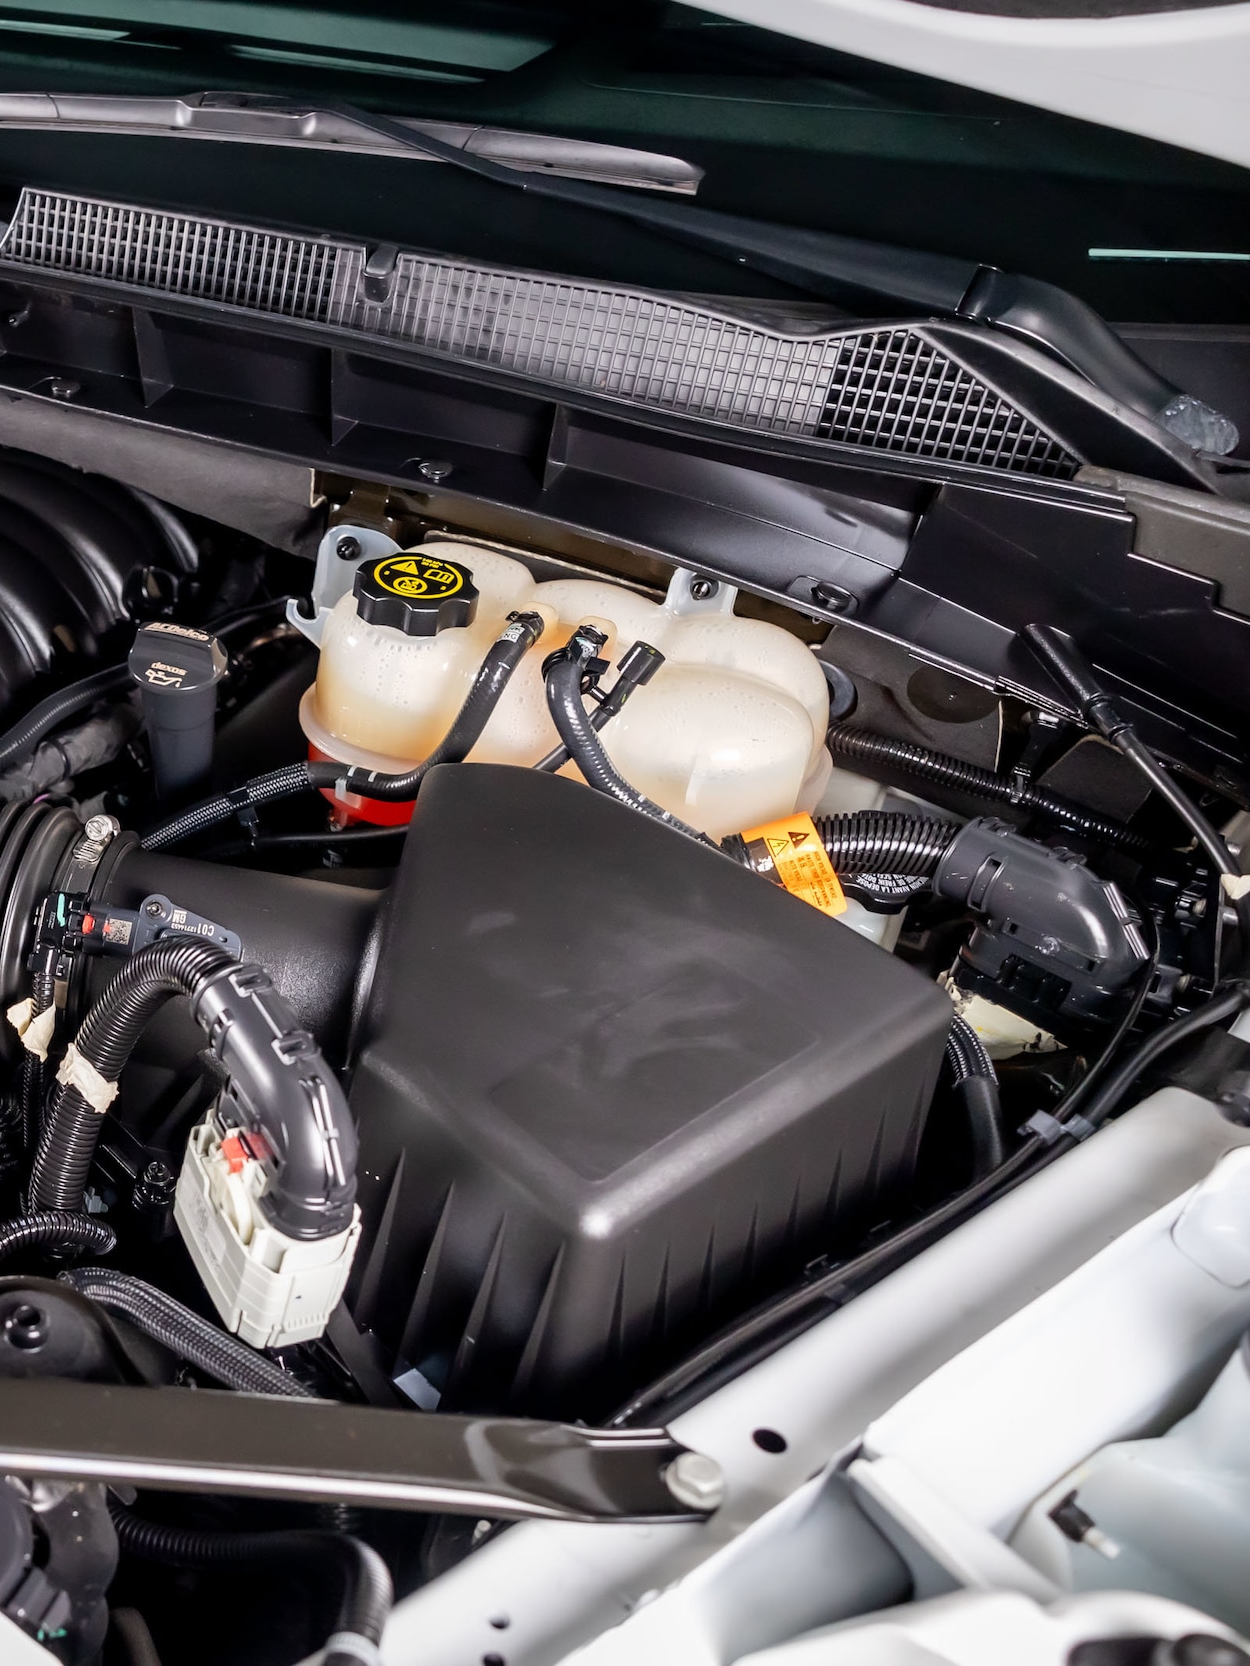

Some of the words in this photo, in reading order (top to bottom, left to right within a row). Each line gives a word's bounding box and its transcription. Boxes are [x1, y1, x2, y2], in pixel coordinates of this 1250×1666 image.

[144, 622, 209, 641] ACDelco
[151, 661, 187, 676] dexos
[892, 885, 910, 894] AVANT
[172, 910, 187, 924] GM
[197, 923, 215, 936] C01
